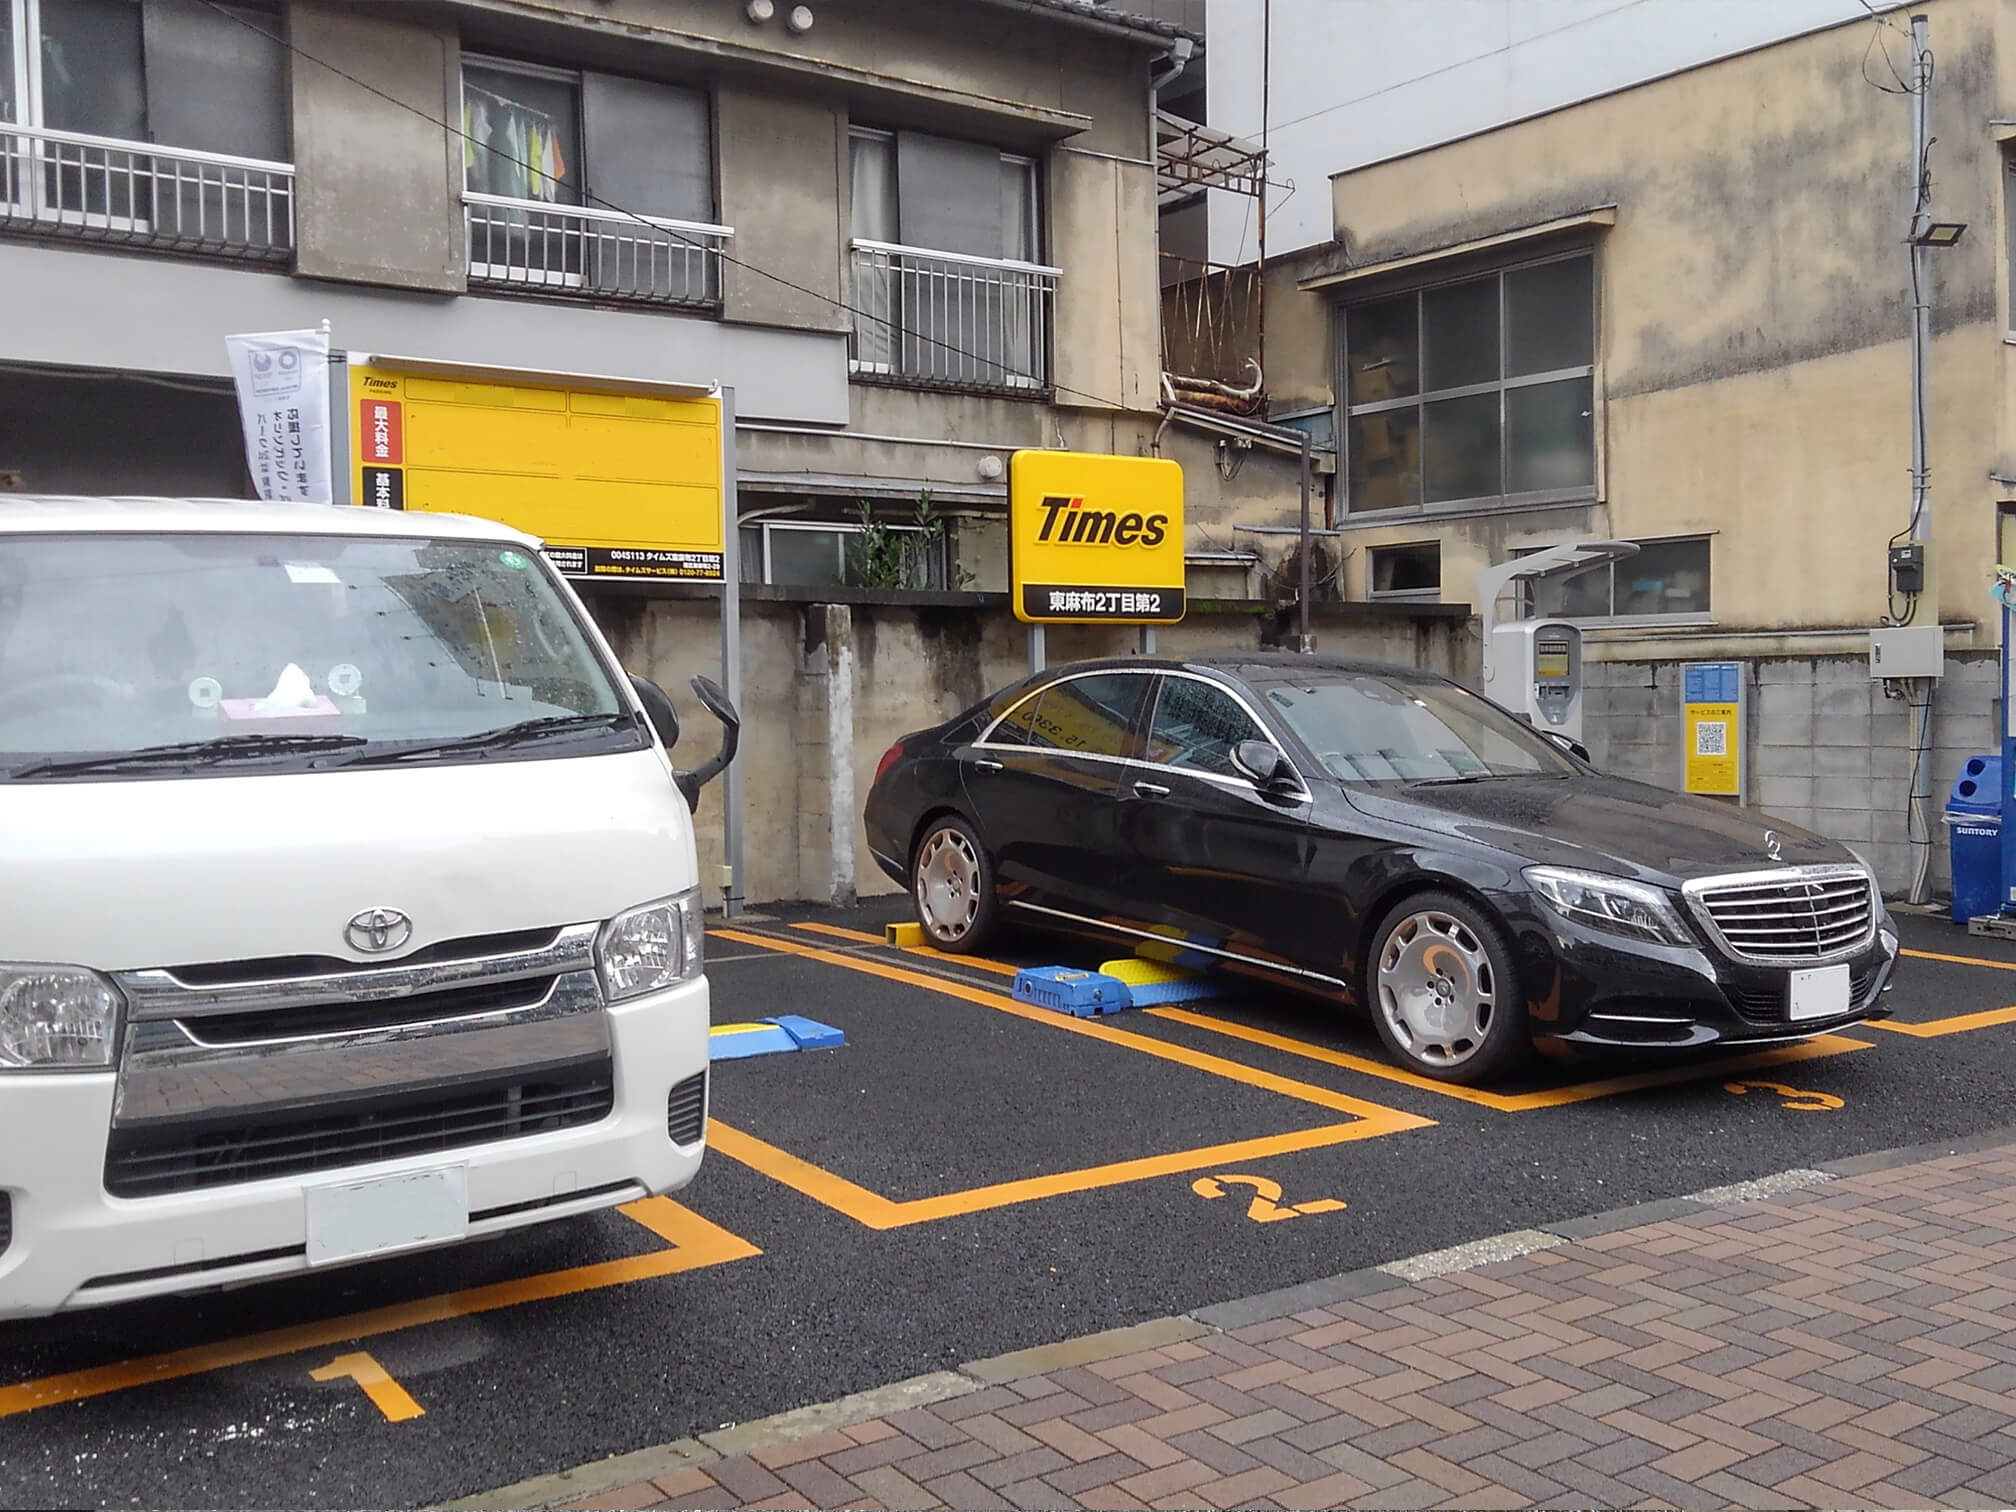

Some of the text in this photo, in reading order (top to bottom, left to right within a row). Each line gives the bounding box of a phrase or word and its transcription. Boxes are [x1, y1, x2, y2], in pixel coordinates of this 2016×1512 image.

[363, 376, 398, 389] Times
[374, 406, 389, 458] 最大料金
[1038, 496, 1169, 546] Times
[1049, 591, 1161, 613] 東麻布2丁目第2
[1723, 1080, 1846, 1111] 3
[1191, 1174, 1348, 1223] 2
[308, 1351, 427, 1423] 1
